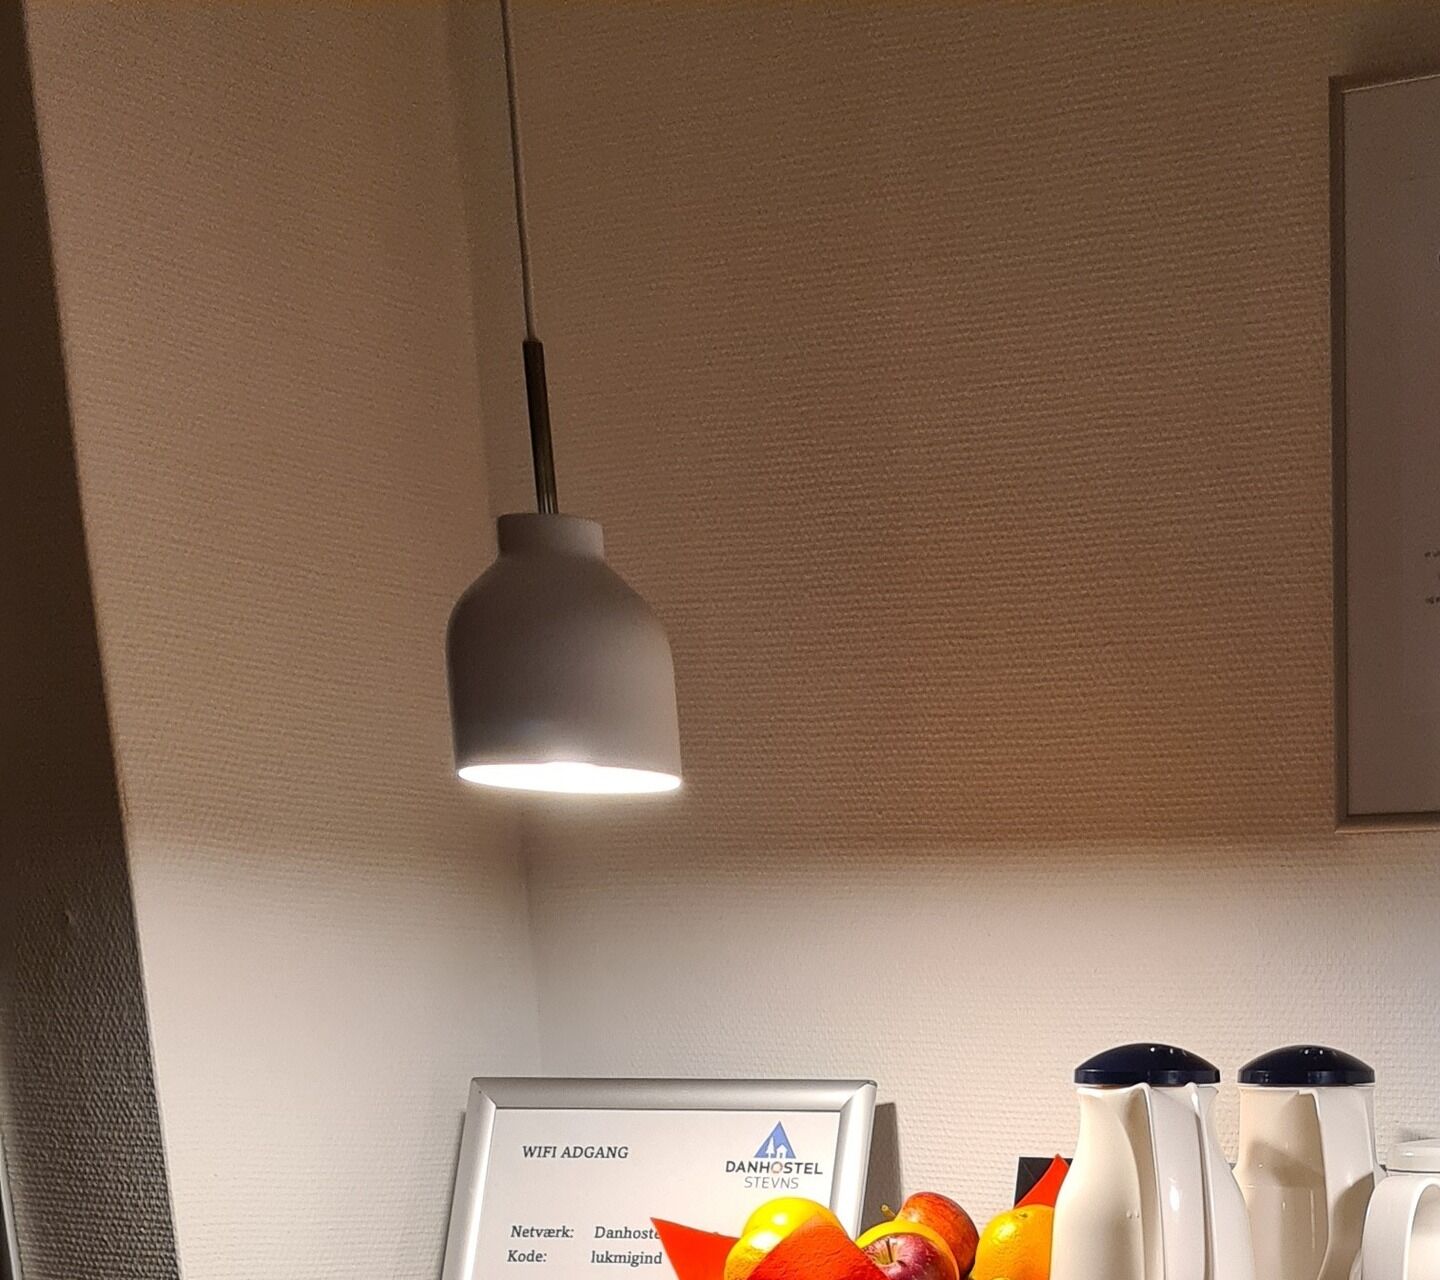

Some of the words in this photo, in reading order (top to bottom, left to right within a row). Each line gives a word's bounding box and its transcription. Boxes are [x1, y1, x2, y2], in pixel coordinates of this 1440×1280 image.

[522, 1145, 557, 1159] WIFI
[561, 1145, 629, 1159] ADGANG
[725, 1160, 823, 1175] DANHOSTEL
[744, 1176, 799, 1189] STEVNS
[511, 1225, 575, 1239] Netværk:
[594, 1226, 662, 1239] Danhoste
[507, 1249, 548, 1262] Kode:
[590, 1250, 663, 1267] lukmigind
